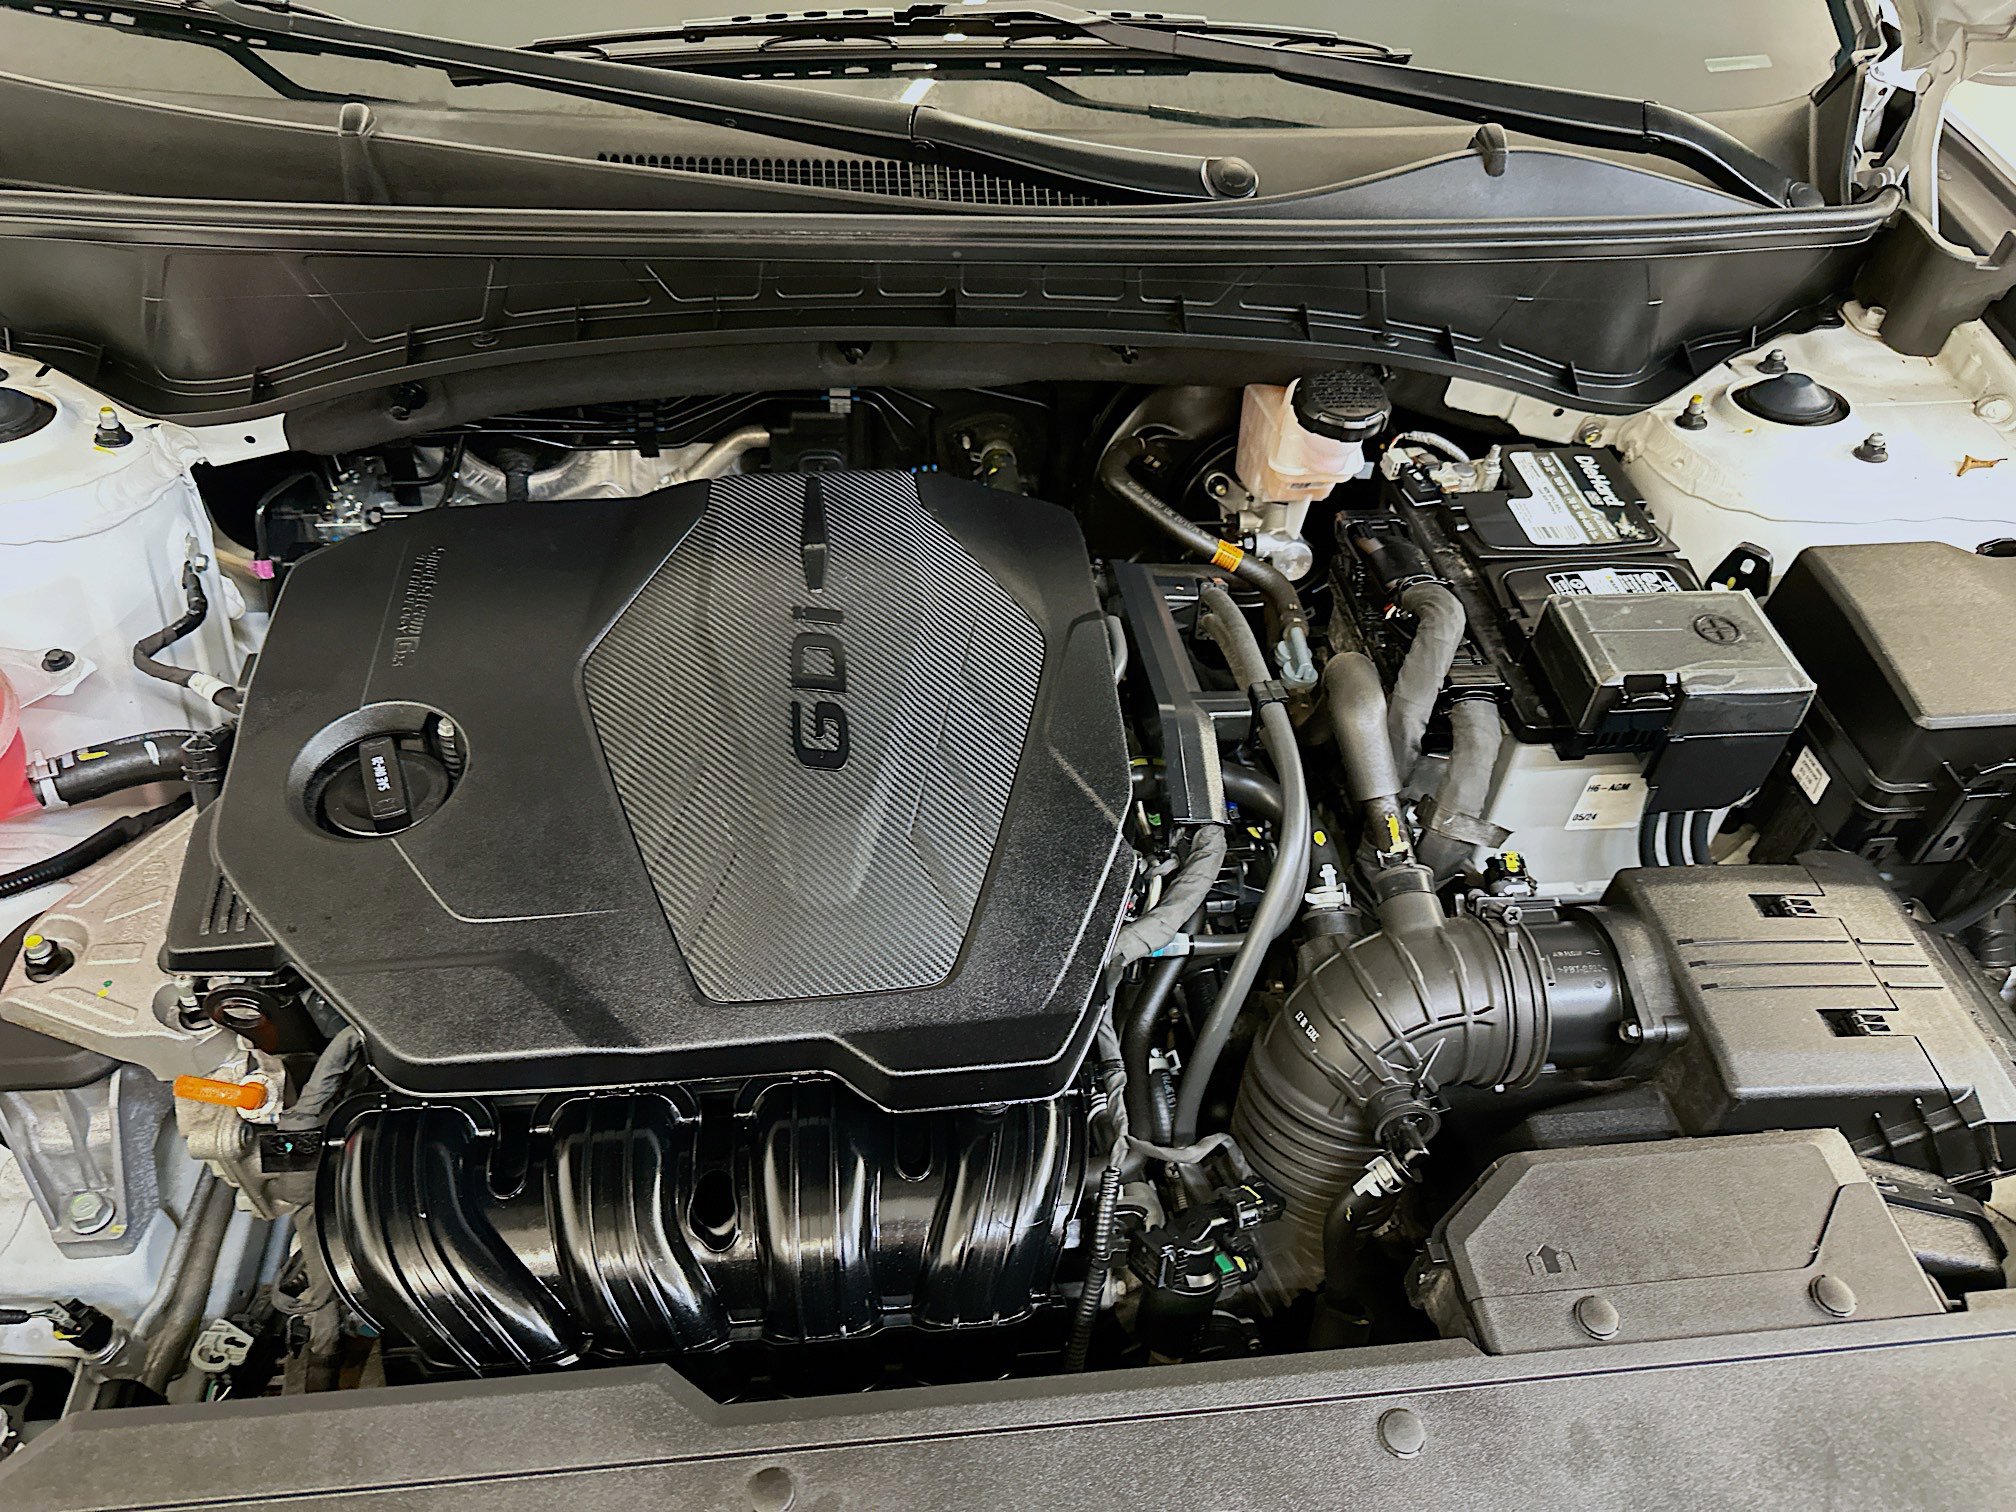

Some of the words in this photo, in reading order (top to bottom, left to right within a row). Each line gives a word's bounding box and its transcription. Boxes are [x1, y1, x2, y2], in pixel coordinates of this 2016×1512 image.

[1573, 455, 1626, 507] DieHard
[375, 775, 391, 791] SAE
[1572, 813, 1598, 821] 05/24
